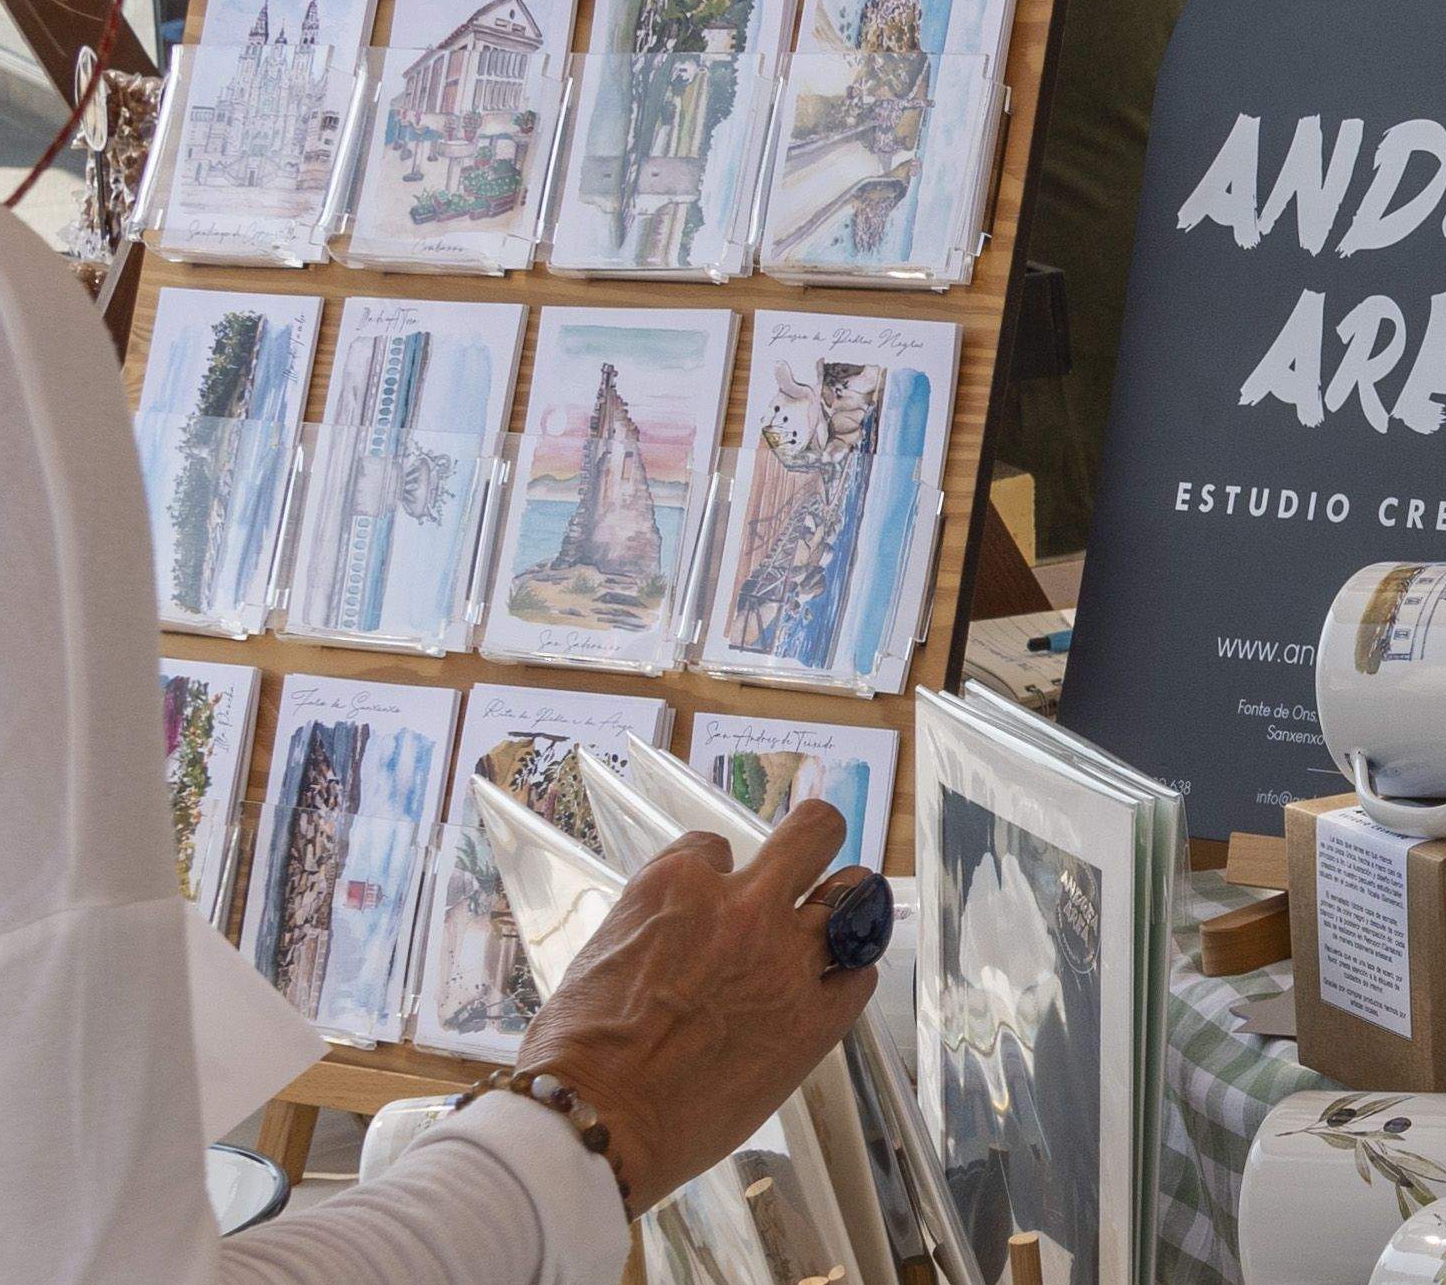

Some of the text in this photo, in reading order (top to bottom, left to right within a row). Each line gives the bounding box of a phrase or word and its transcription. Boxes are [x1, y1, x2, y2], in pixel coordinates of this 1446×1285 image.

[1174, 481, 1351, 523] ESTUDIO
[1217, 636, 1316, 666] www.an
[1237, 699, 1271, 717] Fonte
[1273, 704, 1290, 720] de
[1266, 724, 1326, 746] Sanxenxo
